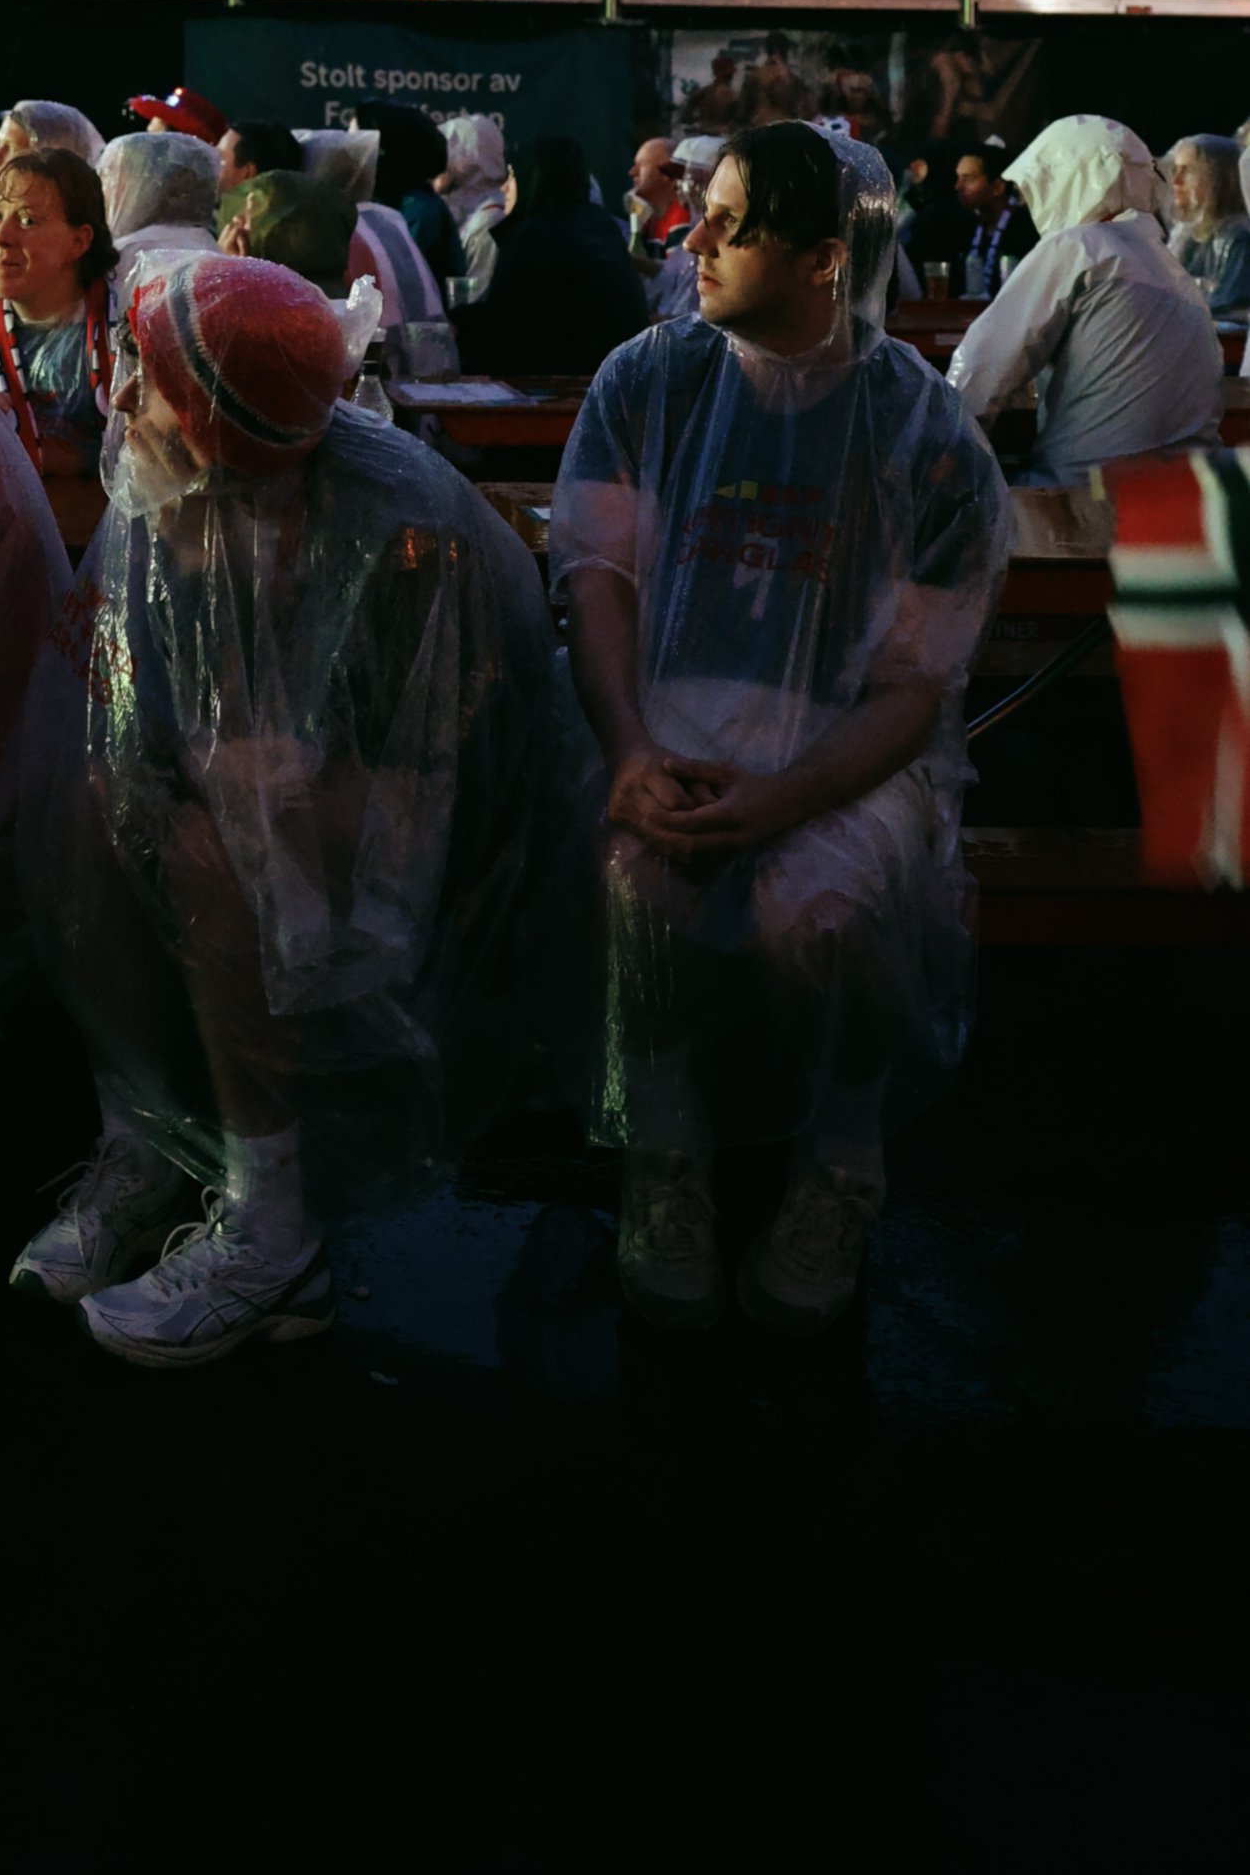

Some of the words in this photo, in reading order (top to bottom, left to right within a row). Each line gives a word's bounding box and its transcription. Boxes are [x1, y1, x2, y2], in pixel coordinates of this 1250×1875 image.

[301, 61, 366, 88] Stolt
[374, 68, 482, 95] sponsor
[489, 73, 522, 93] av
